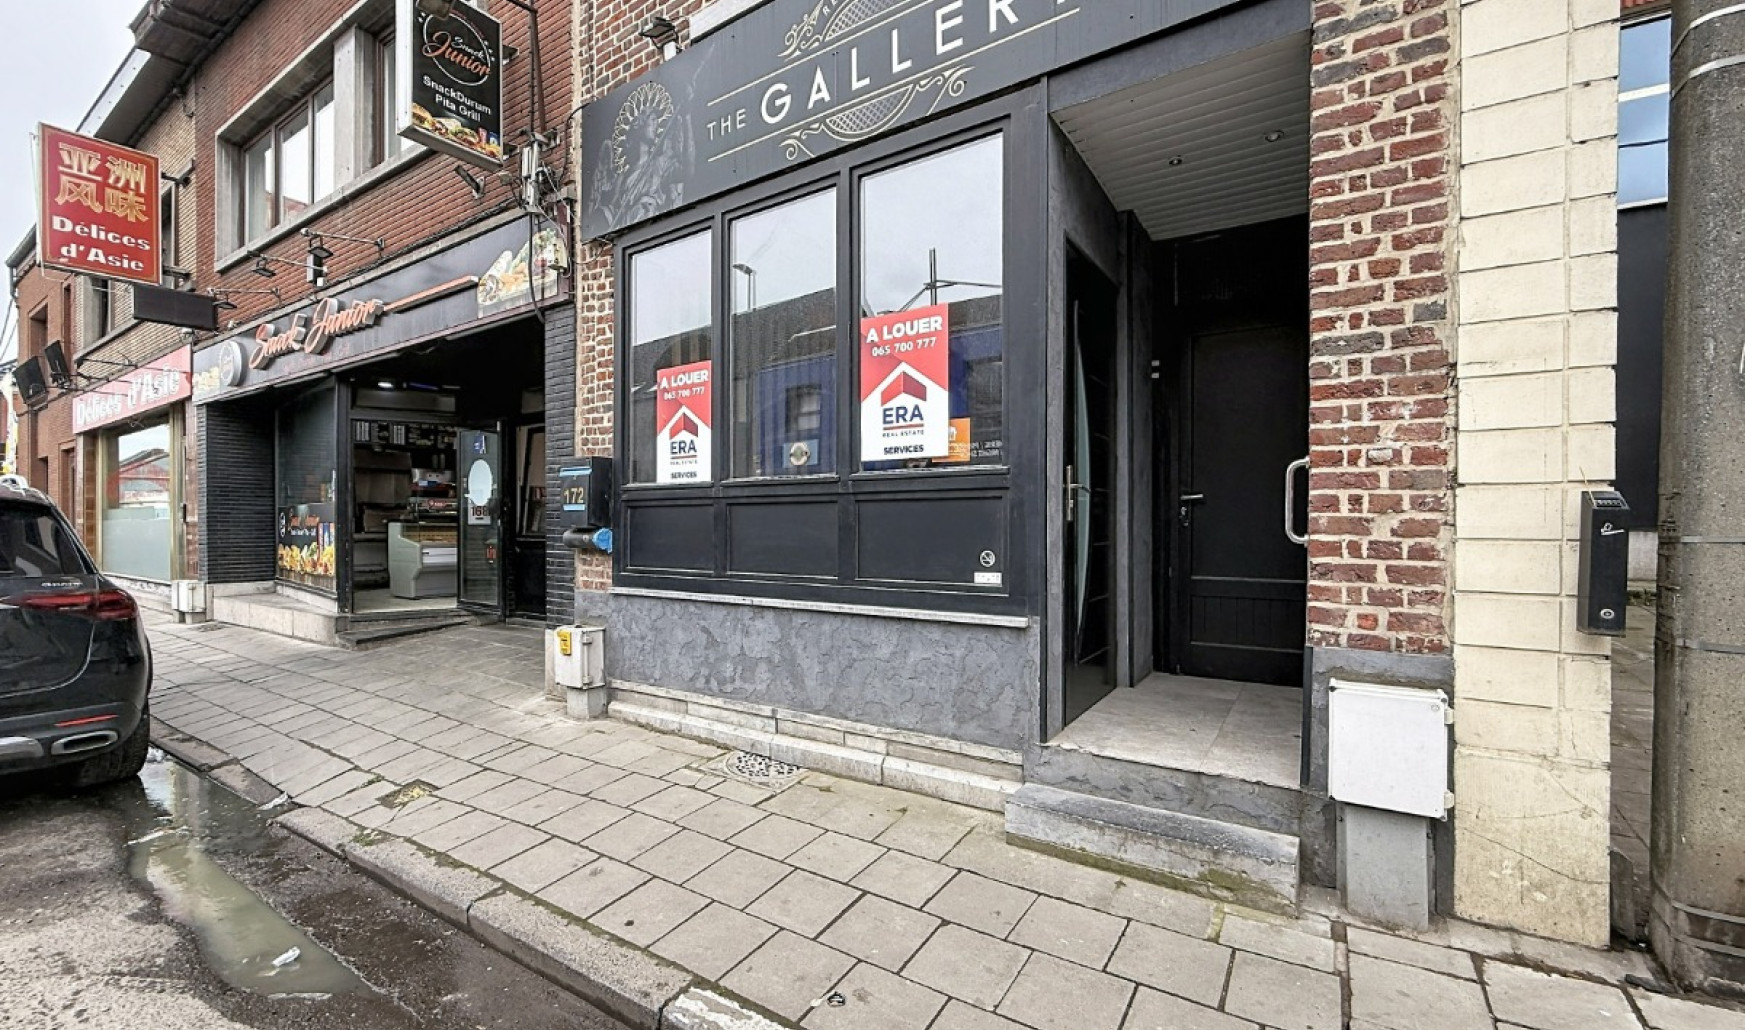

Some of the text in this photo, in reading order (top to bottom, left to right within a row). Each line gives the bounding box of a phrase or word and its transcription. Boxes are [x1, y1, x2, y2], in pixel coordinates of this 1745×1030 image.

[422, 31, 491, 76] Junior
[451, 36, 487, 62] Snack
[706, 0, 1067, 141] THE GALLER
[422, 74, 491, 115] SnackDurum
[435, 93, 481, 122] Pita Grill
[57, 141, 147, 193] 亚洲
[54, 173, 149, 222] 风味
[52, 215, 150, 251] Délices
[60, 243, 145, 271] d'Asie
[304, 298, 383, 353] Junior
[866, 316, 943, 343] A LOUER
[871, 337, 937, 356] 065 700 777
[660, 369, 709, 389] A LOUER
[692, 386, 705, 396] 777
[882, 404, 924, 425] ERA
[670, 439, 698, 455] ERA
[883, 444, 925, 455] SERVICES
[563, 487, 584, 504] 172
